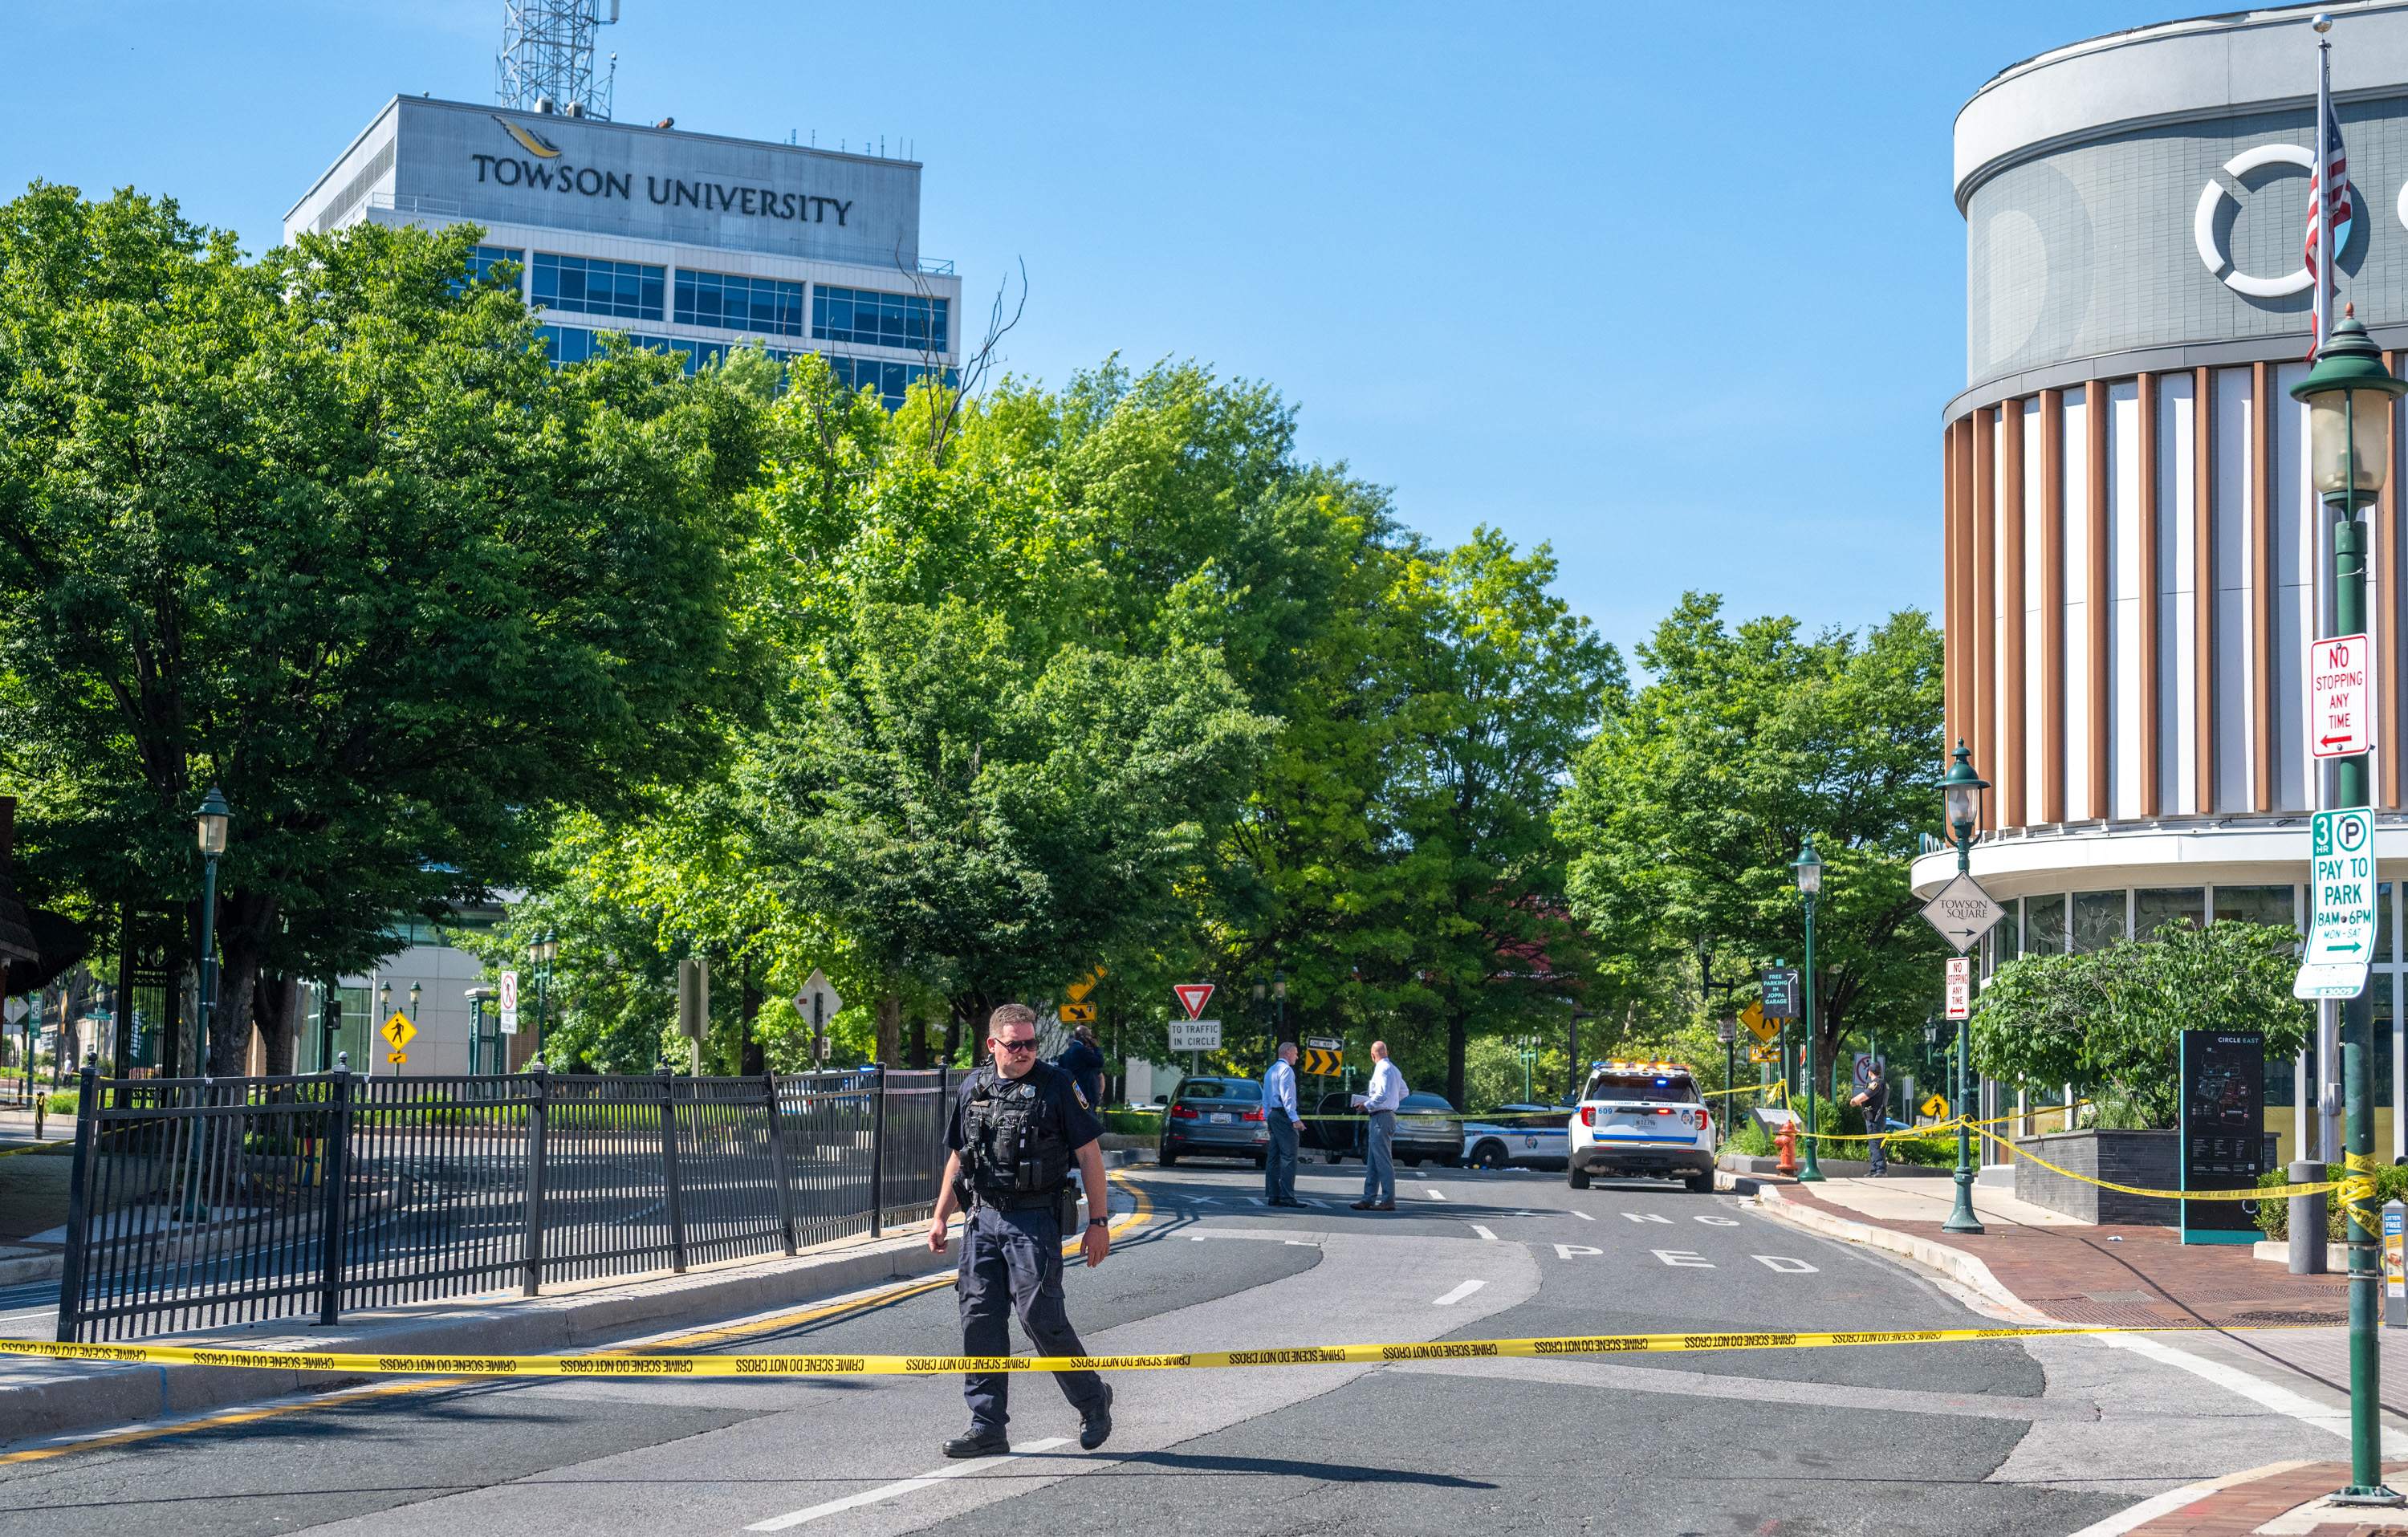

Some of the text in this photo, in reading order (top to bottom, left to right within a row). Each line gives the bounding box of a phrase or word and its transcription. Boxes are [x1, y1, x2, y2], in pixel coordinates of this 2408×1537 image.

[472, 154, 853, 226] TOWSON UNIVERSITY
[2329, 645, 2349, 669] NO
[2316, 671, 2363, 691] STOPPING
[2329, 693, 2349, 710] ANY
[2328, 713, 2351, 729] TIME
[2316, 817, 2329, 845] 3
[2345, 822, 2359, 844] P
[2316, 845, 2329, 854] HR
[2318, 857, 2368, 881] PAY TO
[2325, 884, 2361, 905] PARK
[1939, 900, 1987, 909] TOWSON
[1946, 909, 1987, 920] SQUARE
[2318, 909, 2371, 926] 8AM 6PM
[2324, 929, 2341, 939] MON
[2347, 928, 2361, 937] SAT
[1954, 962, 1962, 973] NO
[1948, 974, 1967, 985] STOPPING
[1952, 986, 1963, 995] ANY
[1952, 997, 1963, 1005] TIME
[32, 1005, 39, 1016] 45
[1172, 1025, 1218, 1034] TO TRAFFIC
[1188, 1037, 1215, 1045] CIRCLE
[1553, 1244, 1820, 1273] PED
[1685, 1334, 1796, 1348] CRIME SCENE DO NOT CROSS
[1832, 1334, 1860, 1343] CROSS
[63, 1346, 76, 1356] DO
[1382, 1344, 1498, 1359] CRIME SCENE DO NOT CROSS
[1535, 1338, 1648, 1353] CRIME SCENE DO NOT CROSS
[79, 1348, 112, 1358] SCENE
[115, 1350, 146, 1360] CRIME
[1229, 1349, 1345, 1364] CRIME SCENE DO NOT CROSS
[193, 1353, 334, 1369] CRIME SCENE DO NOT CROSS
[380, 1359, 516, 1372] CRIME SCENE DO NOT CROSS
[560, 1360, 694, 1372] CRIME SCENE DO NOT CROSS
[736, 1359, 864, 1372] CRIME SCENE DO NOT CROSS
[906, 1359, 1031, 1370] CRIME SCENE DO NOT CROSS
[1071, 1356, 1191, 1368] CRIME SCENE DO NOT CROSS
